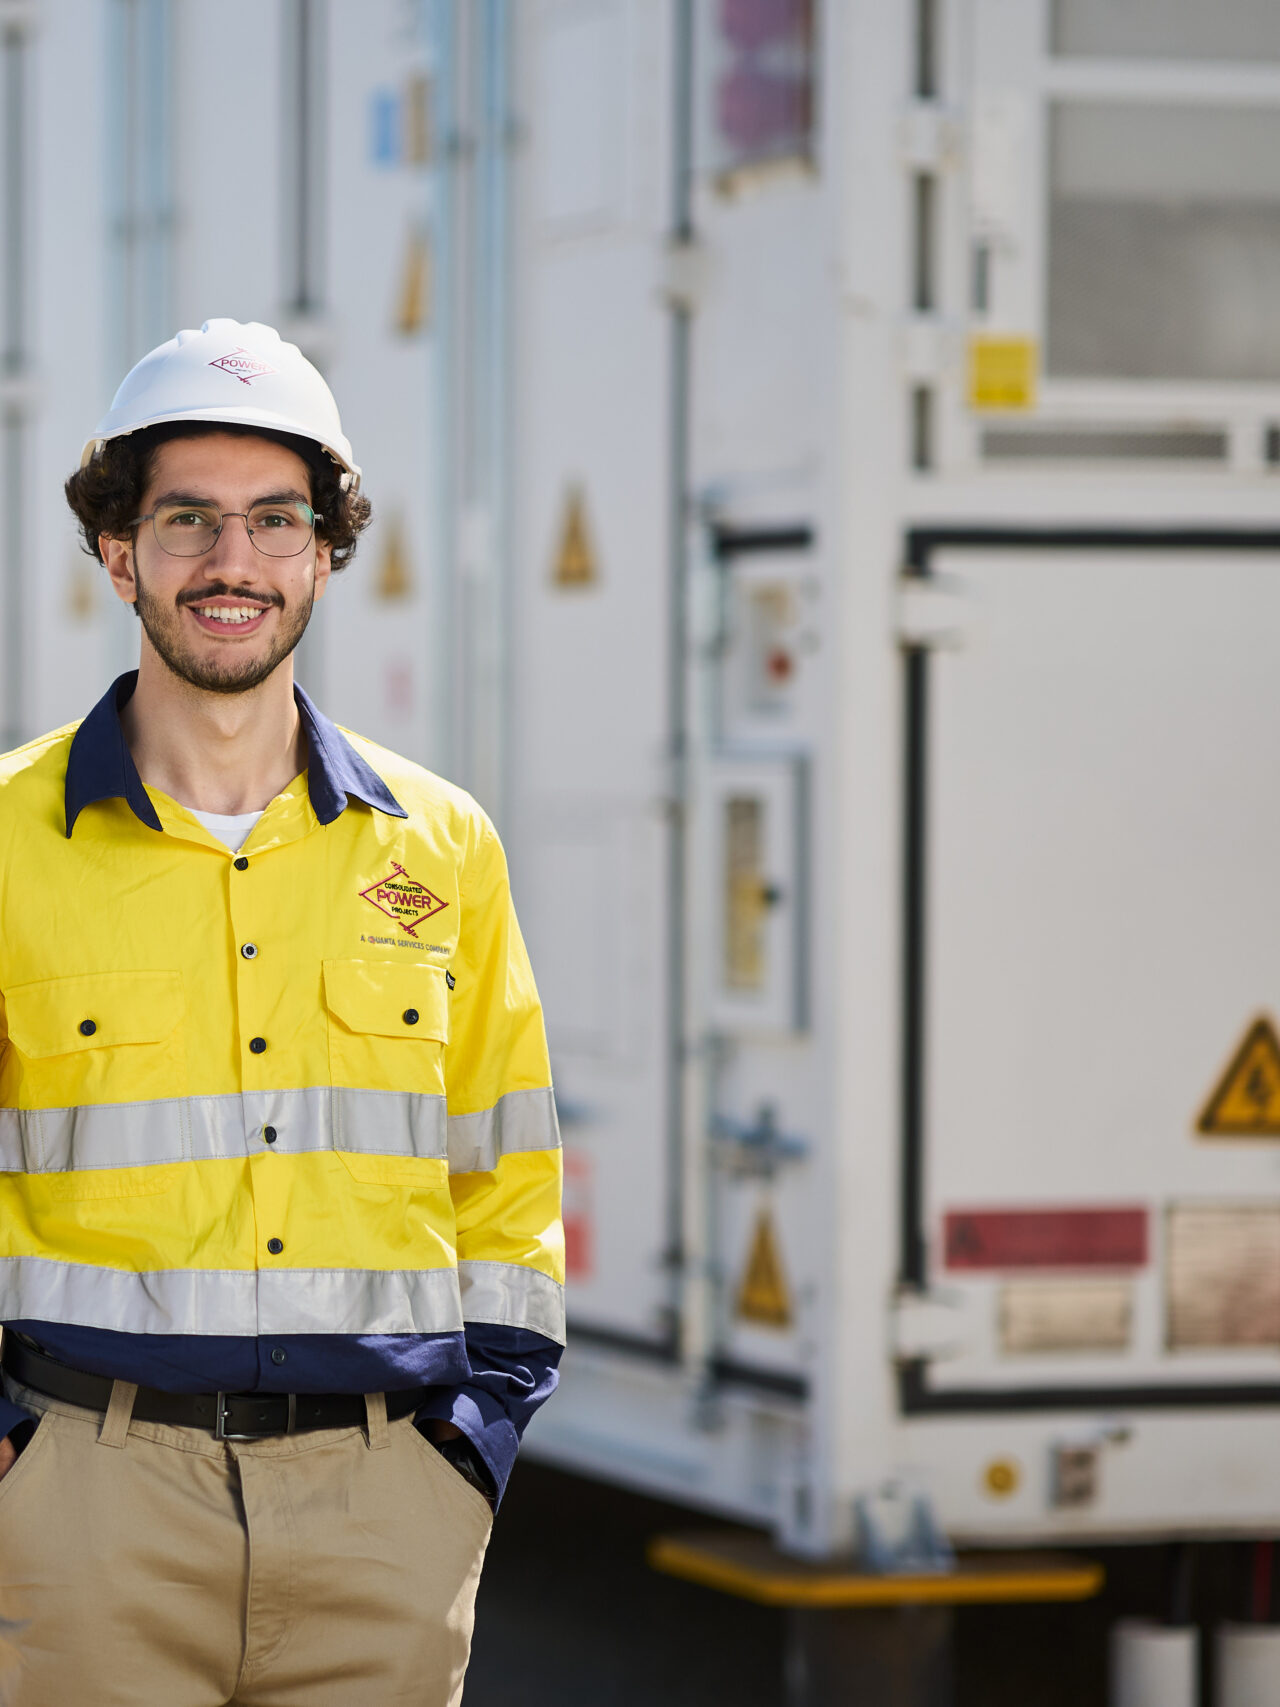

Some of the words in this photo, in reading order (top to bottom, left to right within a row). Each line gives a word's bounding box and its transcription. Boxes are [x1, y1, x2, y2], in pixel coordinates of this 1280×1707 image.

[221, 359, 266, 370] POWER
[384, 882, 423, 893] CONSOLIDATED
[376, 888, 432, 910] POWER
[391, 906, 419, 916] PROJECTS
[397, 938, 425, 950] SERVICES
[425, 943, 450, 955] COMPANY
